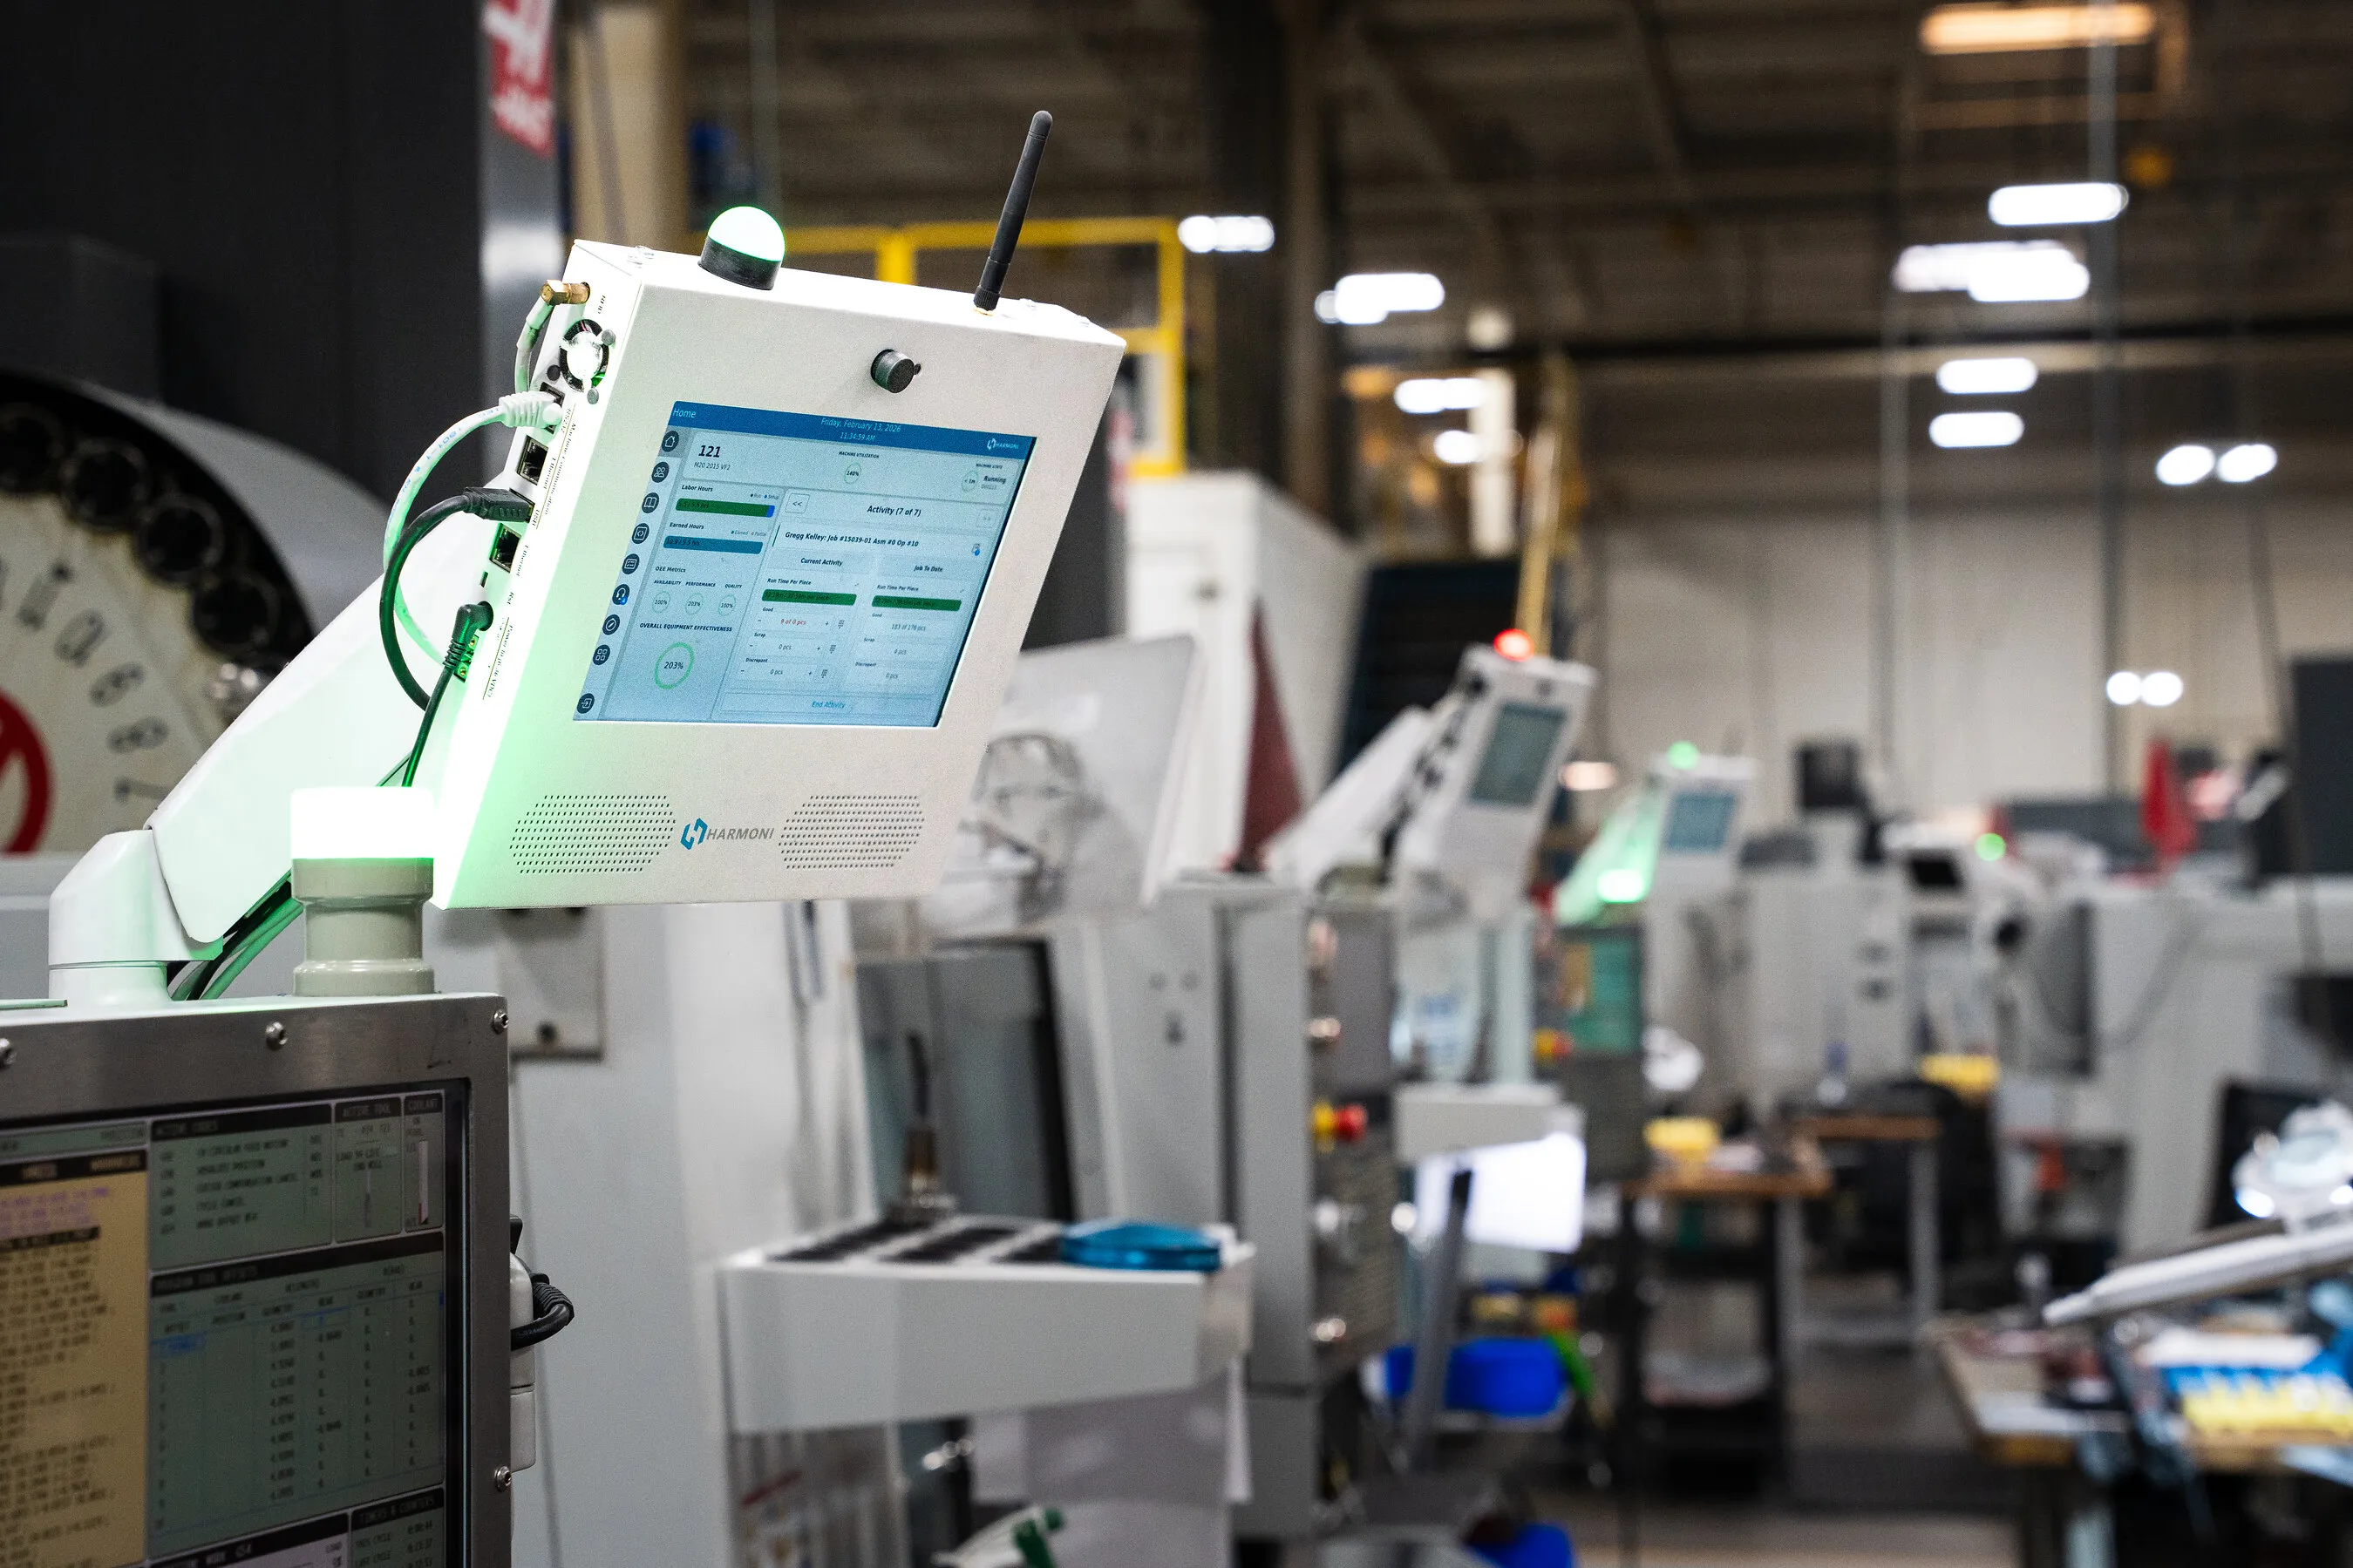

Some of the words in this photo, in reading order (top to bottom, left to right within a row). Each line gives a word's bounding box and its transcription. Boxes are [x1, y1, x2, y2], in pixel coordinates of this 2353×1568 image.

[673, 408, 697, 418] Home
[821, 417, 842, 427] Friday,
[844, 420, 872, 431] February
[874, 423, 882, 431] 13,
[697, 445, 721, 458] 121
[983, 475, 1006, 485] Running
[532, 509, 541, 526] USB
[867, 506, 894, 515] Activity
[895, 507, 904, 516] (7
[914, 509, 921, 518] 7)
[785, 532, 804, 540] Gregg
[806, 533, 826, 542] Kelley:
[839, 535, 872, 544] #15039-01
[503, 624, 513, 648] Power
[663, 661, 683, 669] 203%
[706, 828, 774, 840] HARMONI
